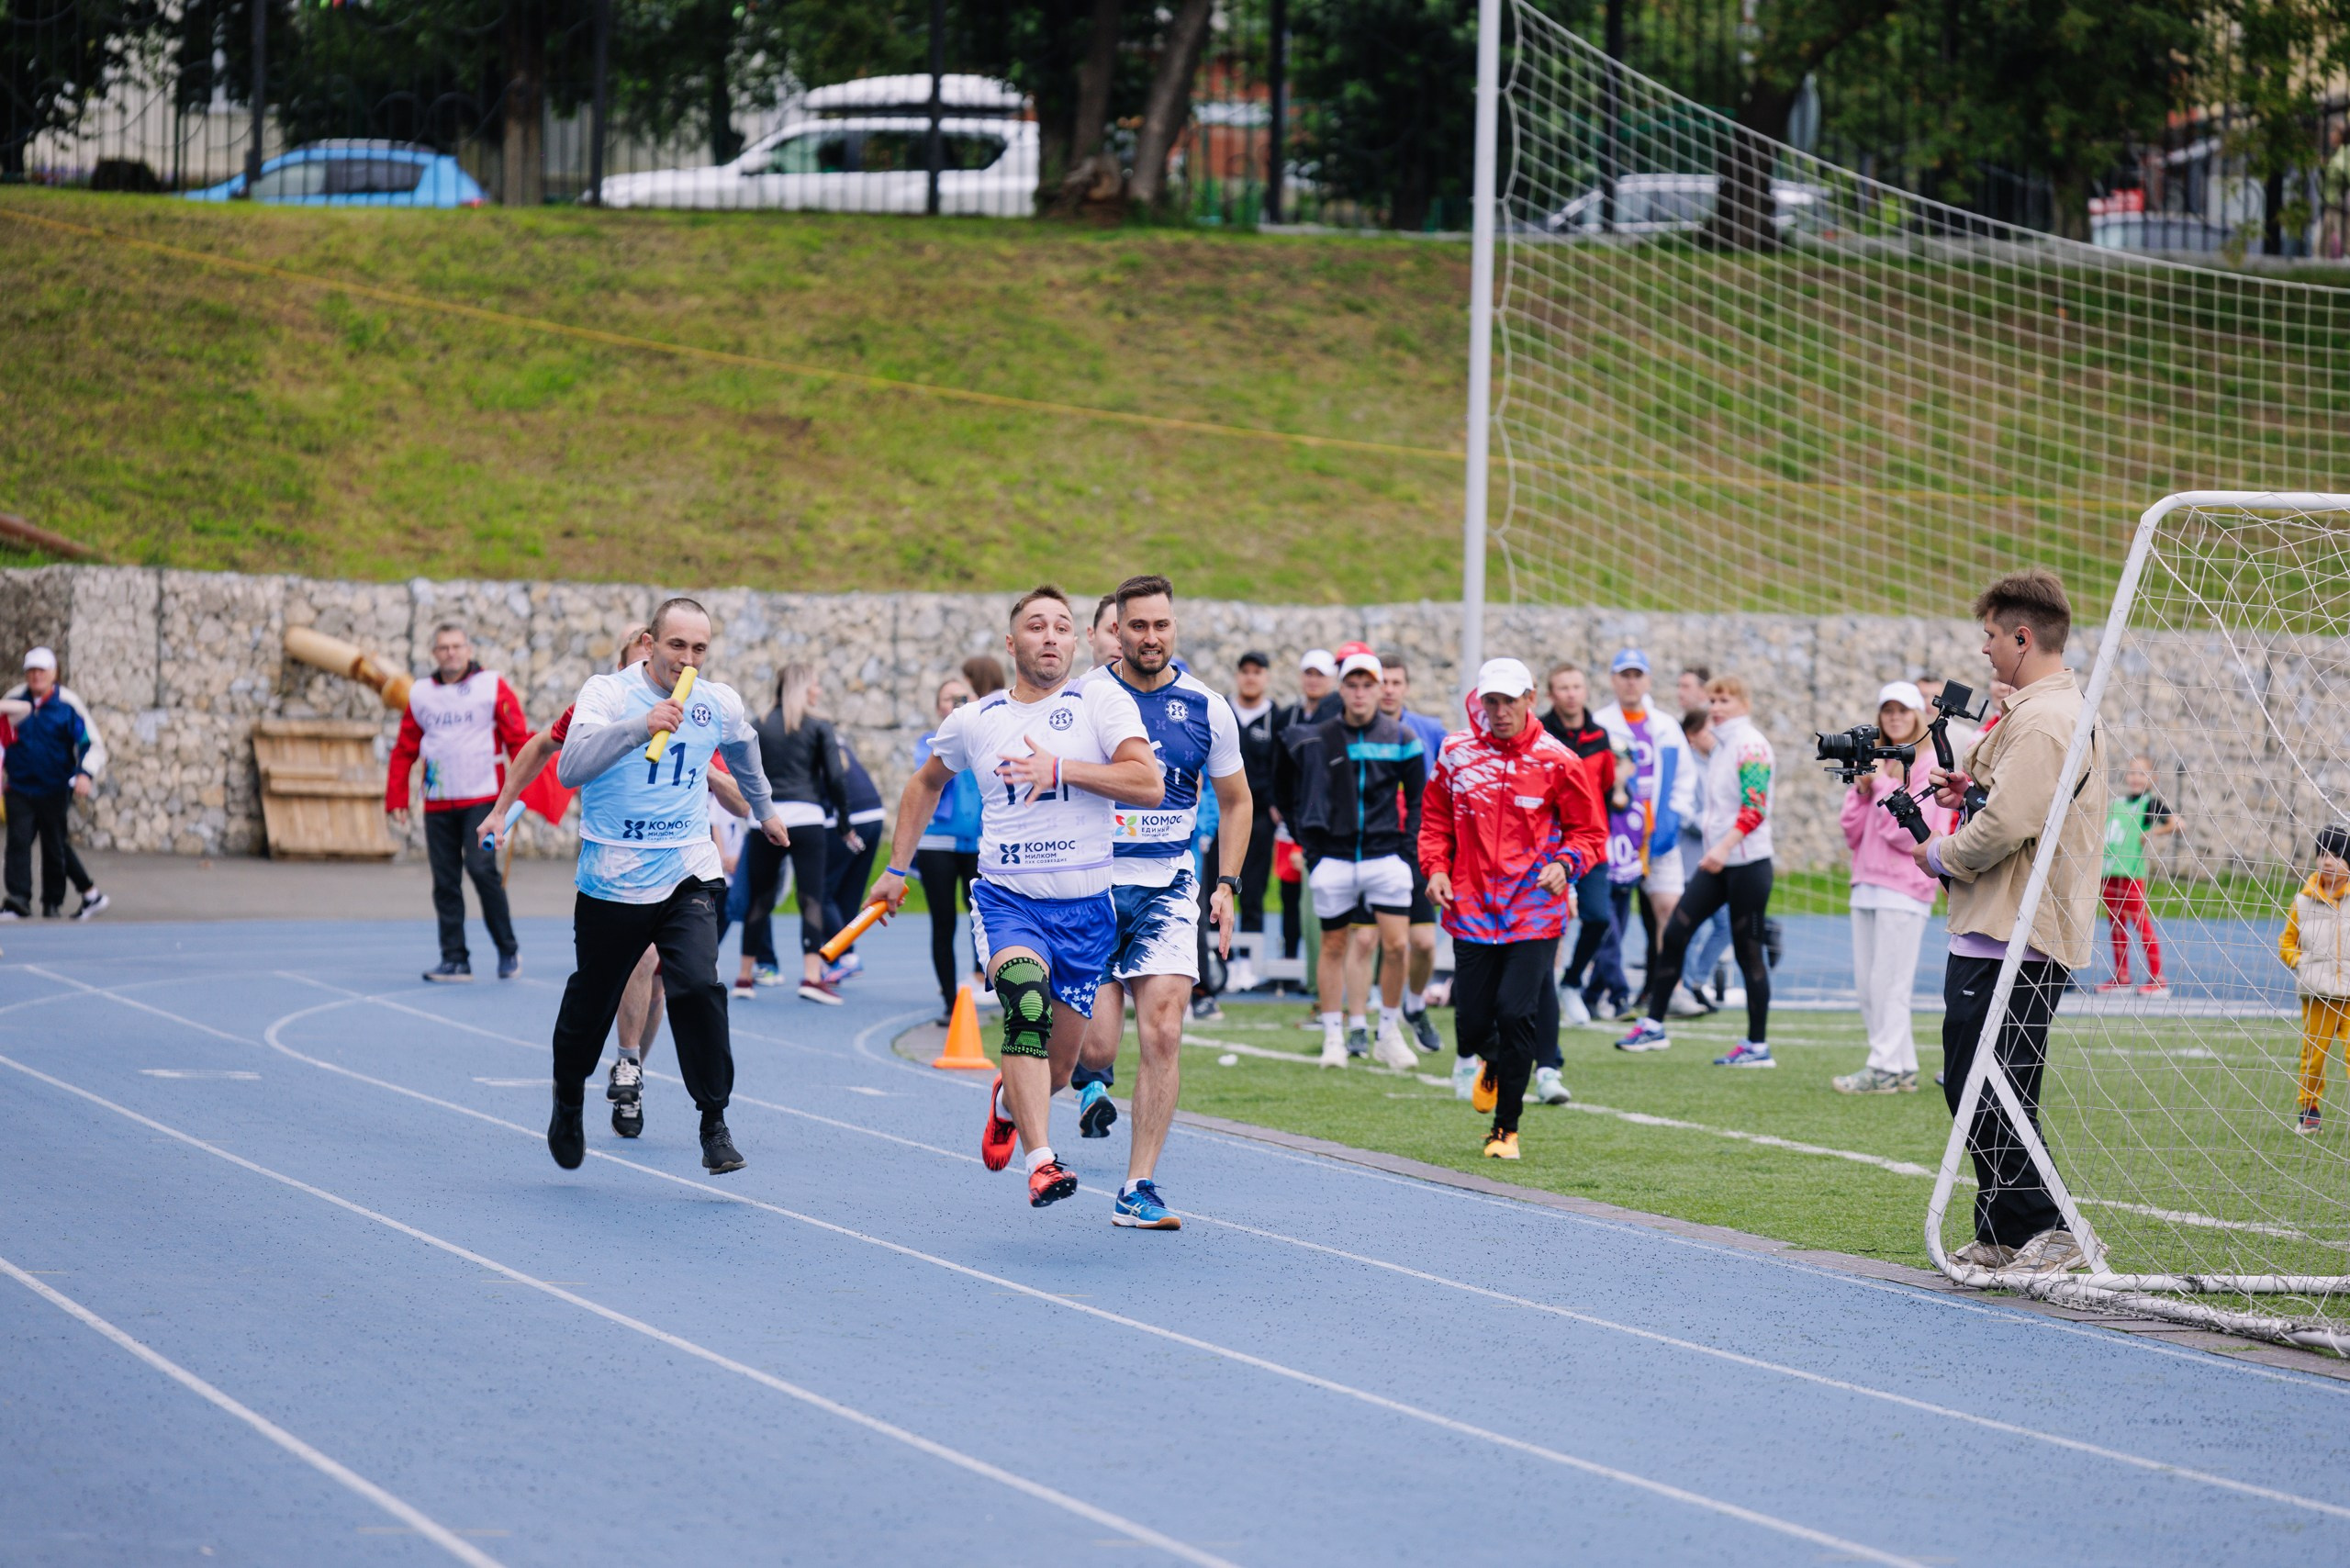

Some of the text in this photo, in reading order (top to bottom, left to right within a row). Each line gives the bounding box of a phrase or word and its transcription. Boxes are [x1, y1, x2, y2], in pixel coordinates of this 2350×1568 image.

[425, 711, 473, 725] СУДЬЯ
[1141, 815, 1182, 826] КОМОС
[1024, 840, 1076, 853] КОМОС
[1024, 852, 1057, 860] МИЛКОМ
